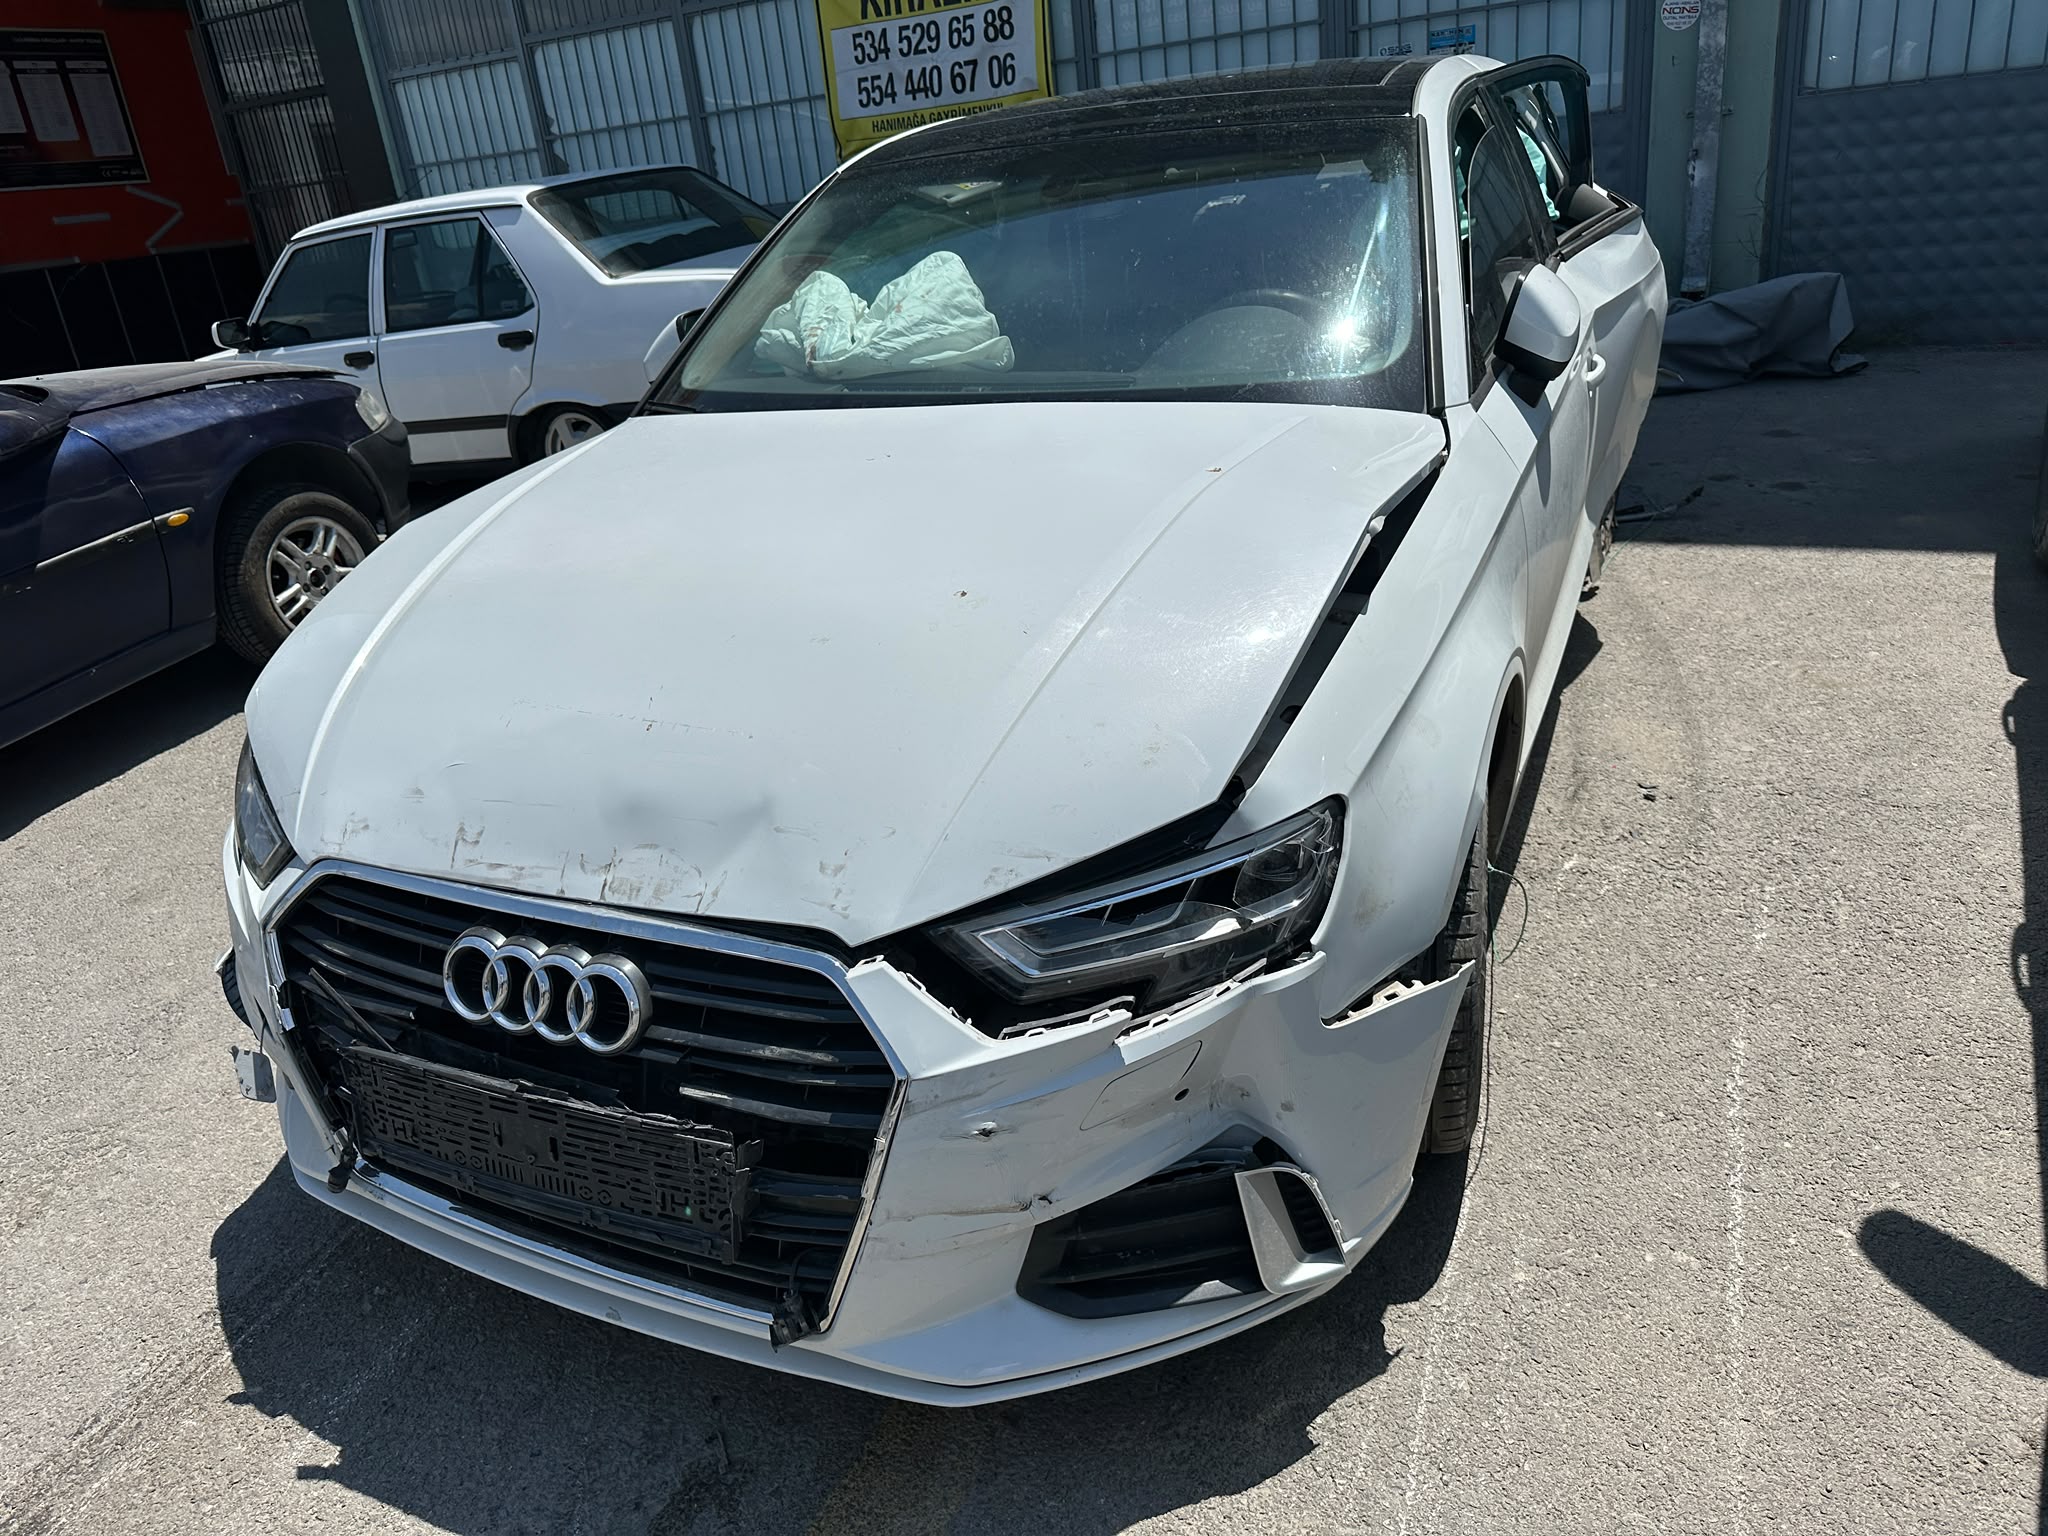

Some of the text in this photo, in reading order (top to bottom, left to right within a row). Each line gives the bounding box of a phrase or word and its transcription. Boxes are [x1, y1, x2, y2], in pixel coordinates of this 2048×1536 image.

[1663, 6, 1699, 14] NONS
[852, 27, 890, 65] 534
[898, 20, 941, 57] 529
[948, 13, 975, 50] 65
[983, 6, 1015, 43] 88
[857, 52, 1016, 109] 554 440 67 06
[872, 113, 926, 133] HANIMAĞA
